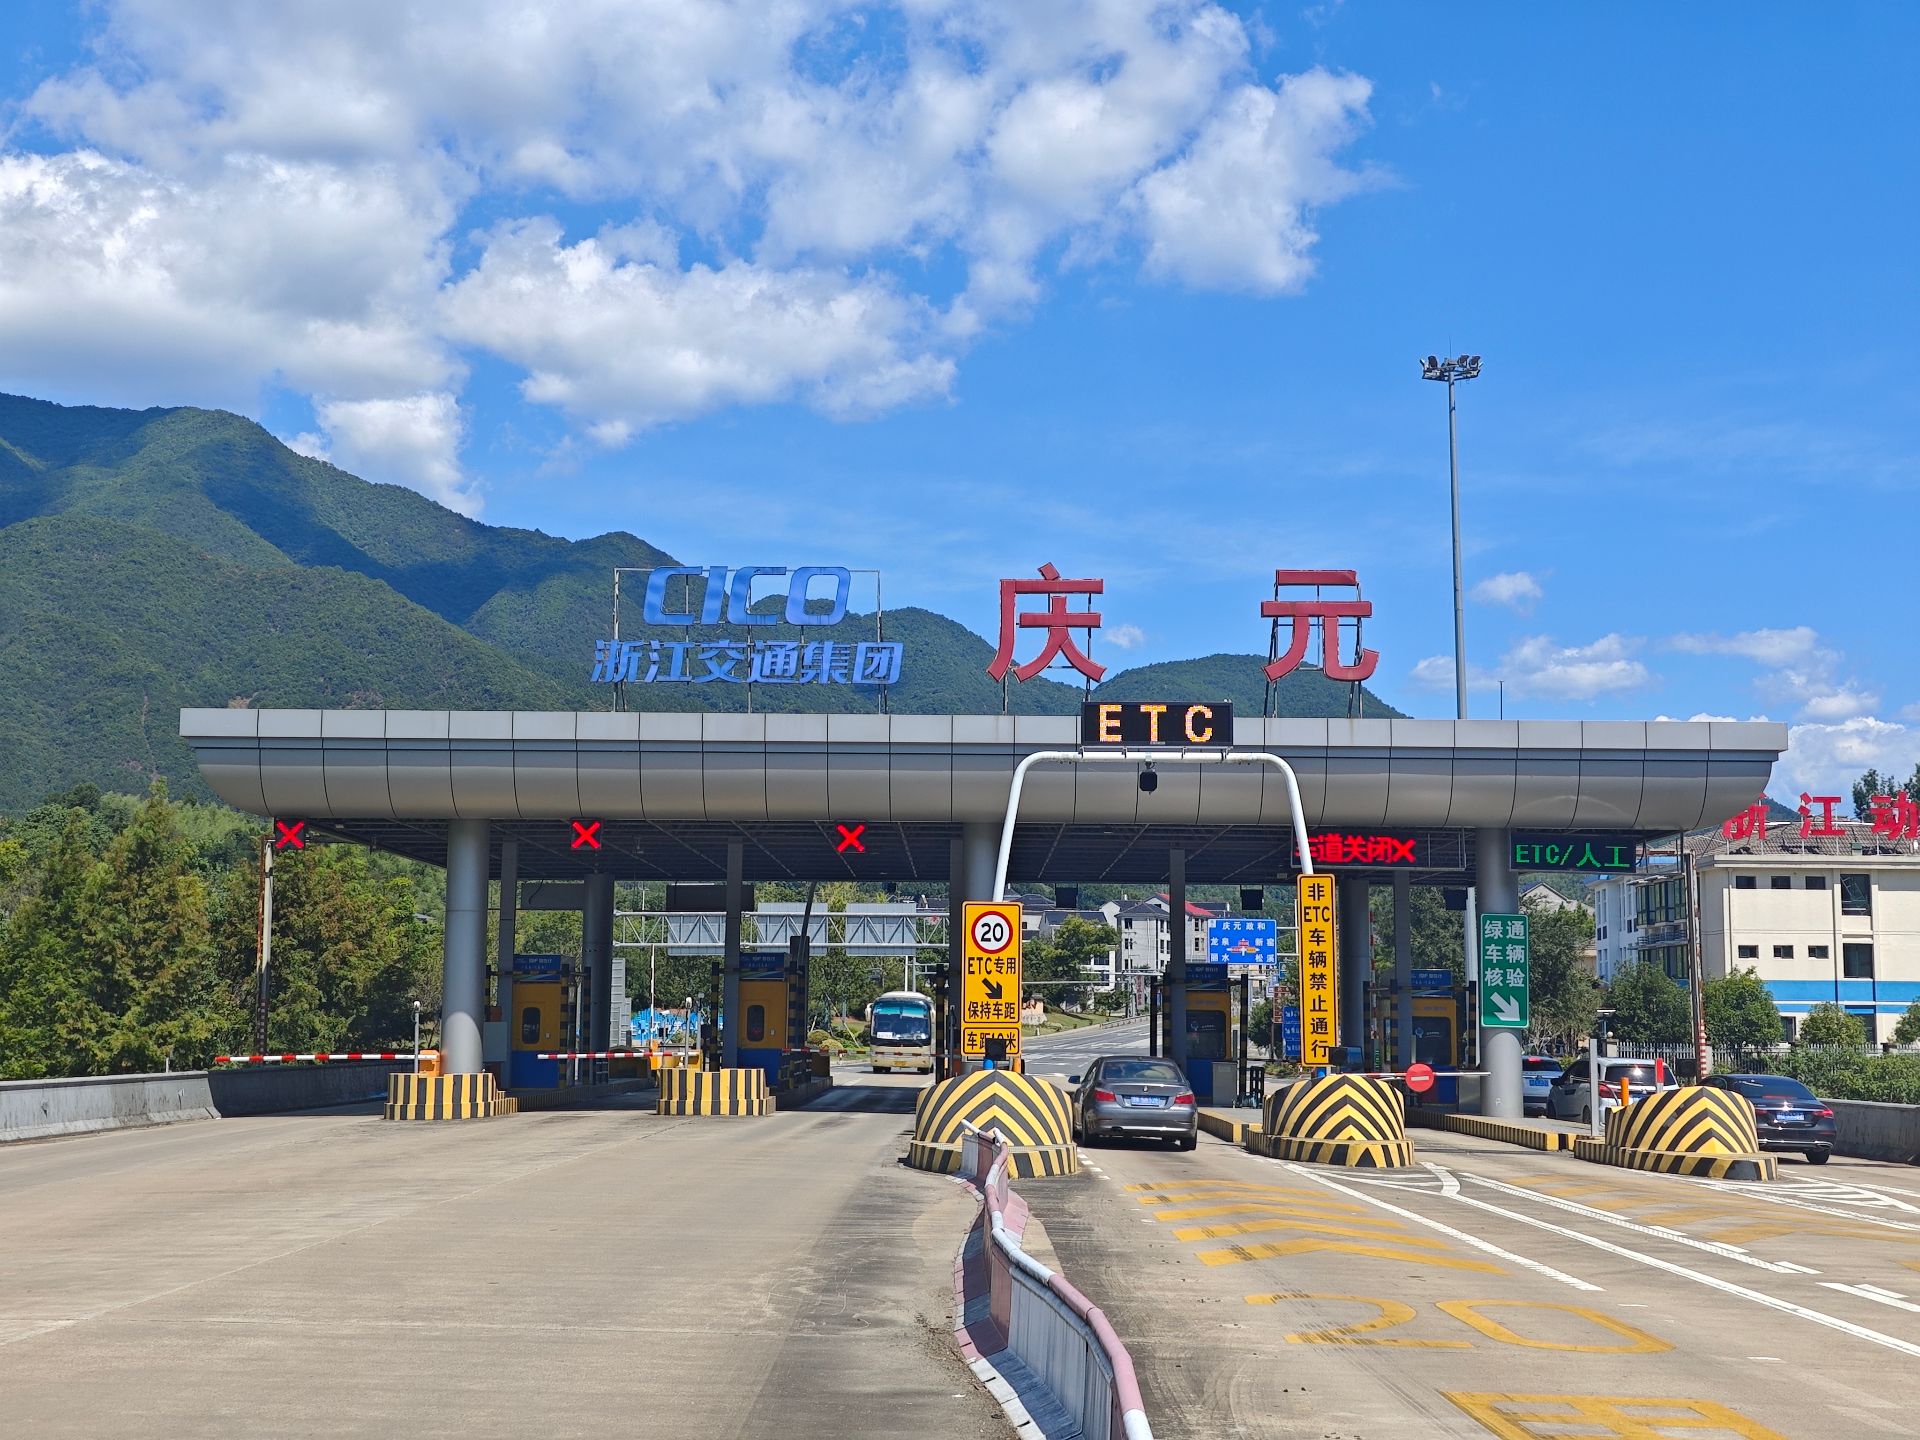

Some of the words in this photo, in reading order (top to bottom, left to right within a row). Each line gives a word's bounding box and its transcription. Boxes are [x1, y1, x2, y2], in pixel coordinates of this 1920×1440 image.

[643, 566, 851, 626] CICO
[987, 562, 1380, 683] 庆元
[590, 640, 904, 684] 浙江交通集团
[1099, 705, 1214, 742] ETC
[981, 923, 1003, 942] 20
[1484, 920, 1525, 940] 绿通
[1484, 944, 1525, 964] 车辆
[968, 957, 1016, 975] ETC专用
[1484, 967, 1525, 988] 核验
[968, 1001, 1016, 1020] 保持车距
[1244, 1292, 1676, 1354] 20
